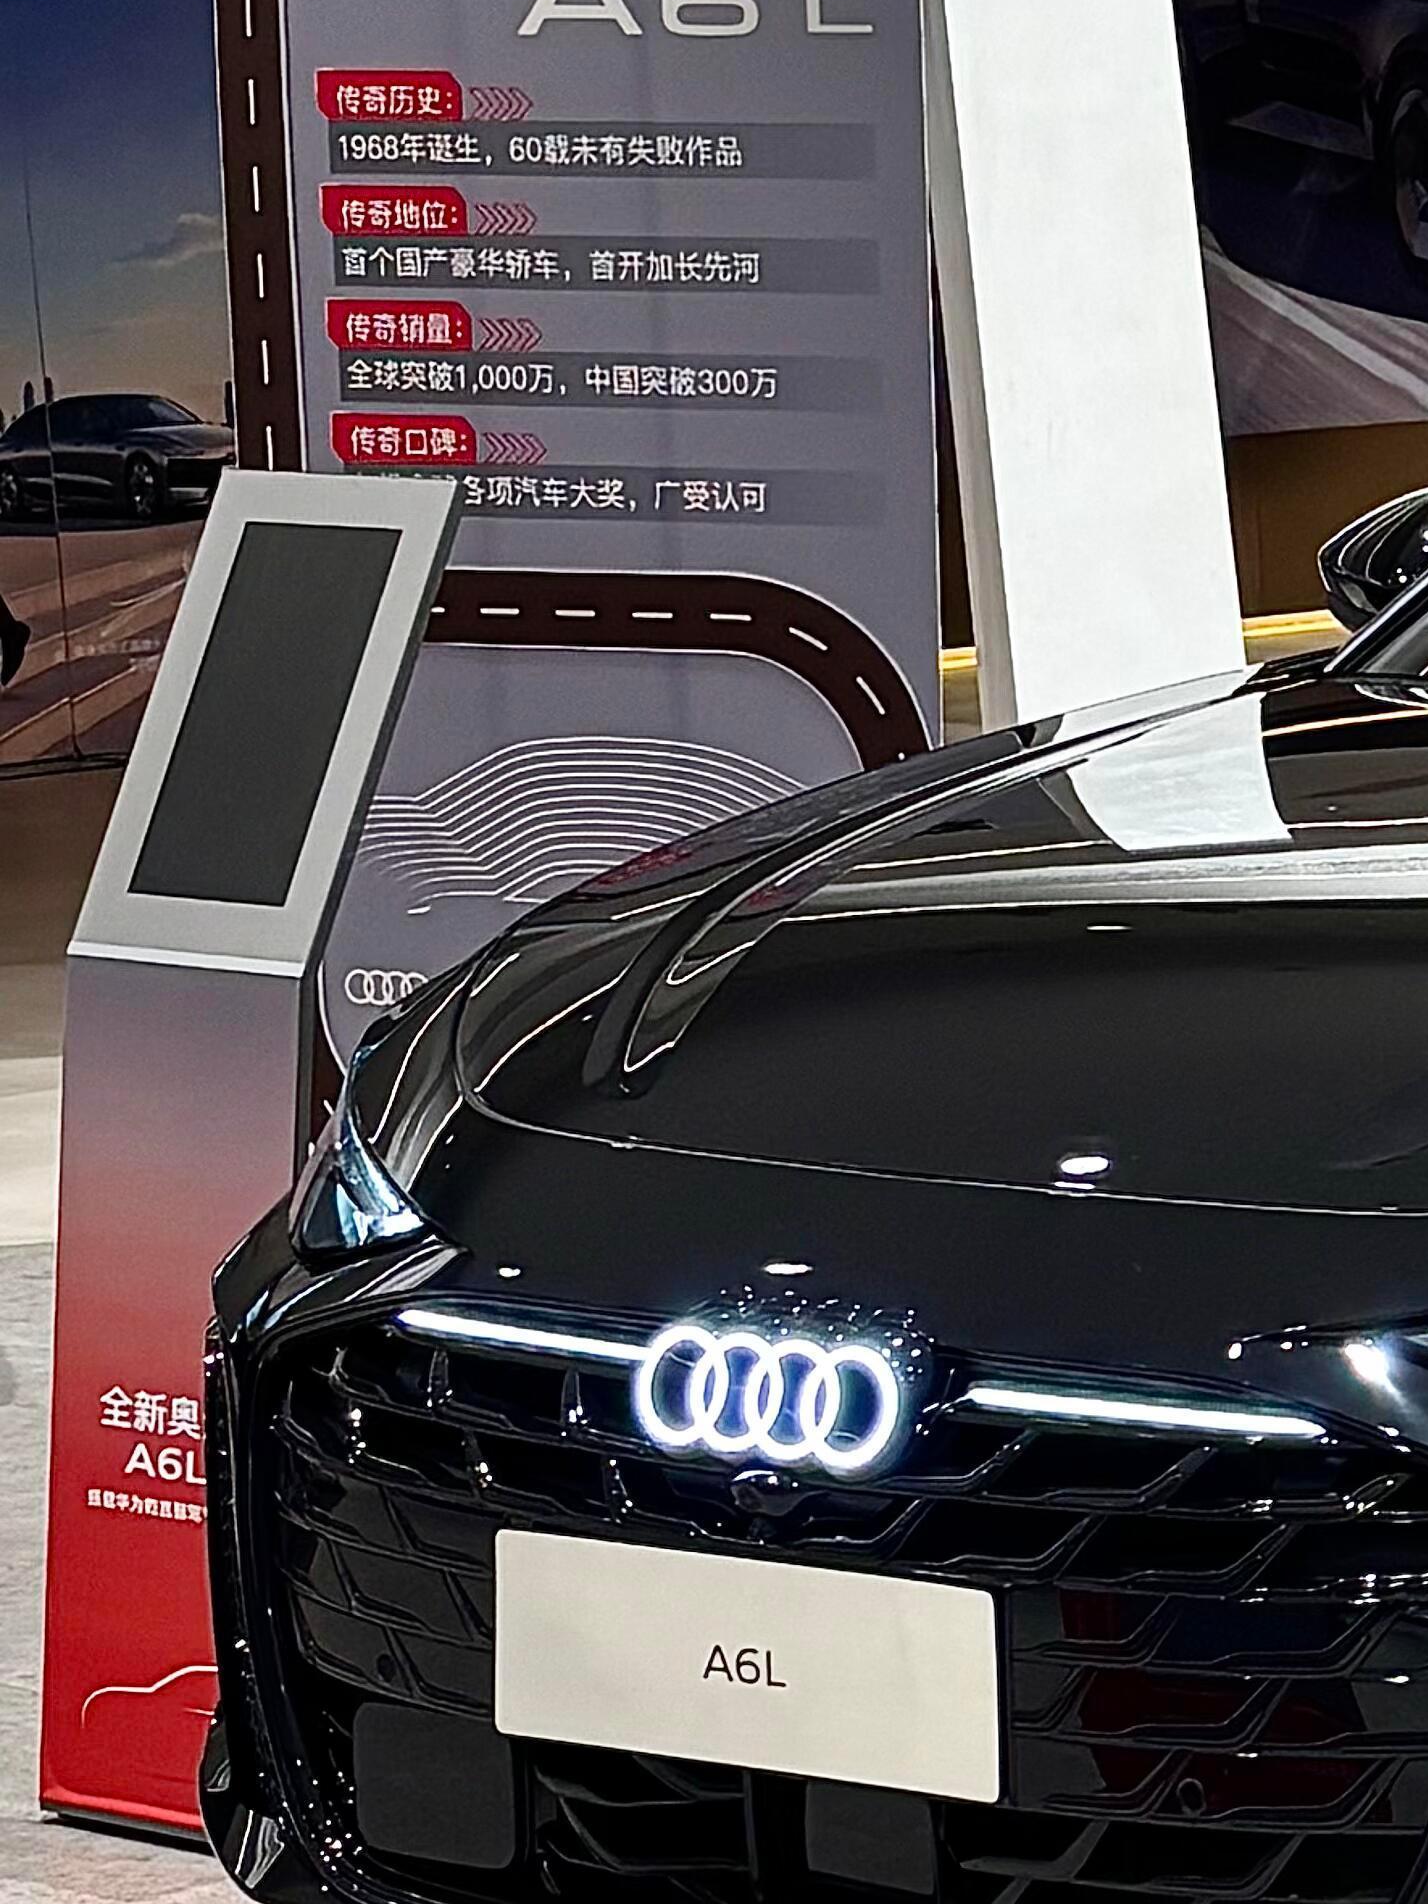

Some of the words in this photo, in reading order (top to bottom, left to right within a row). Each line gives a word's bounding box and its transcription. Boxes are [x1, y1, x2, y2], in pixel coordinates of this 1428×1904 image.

[336, 83, 454, 116] 传奇历史：
[341, 199, 458, 230] 传奇地位：
[350, 425, 468, 457] 传奇口碑：
[100, 1385, 206, 1440] 全新奥
[124, 1442, 207, 1485] A6L
[702, 1643, 788, 1689] A6L
